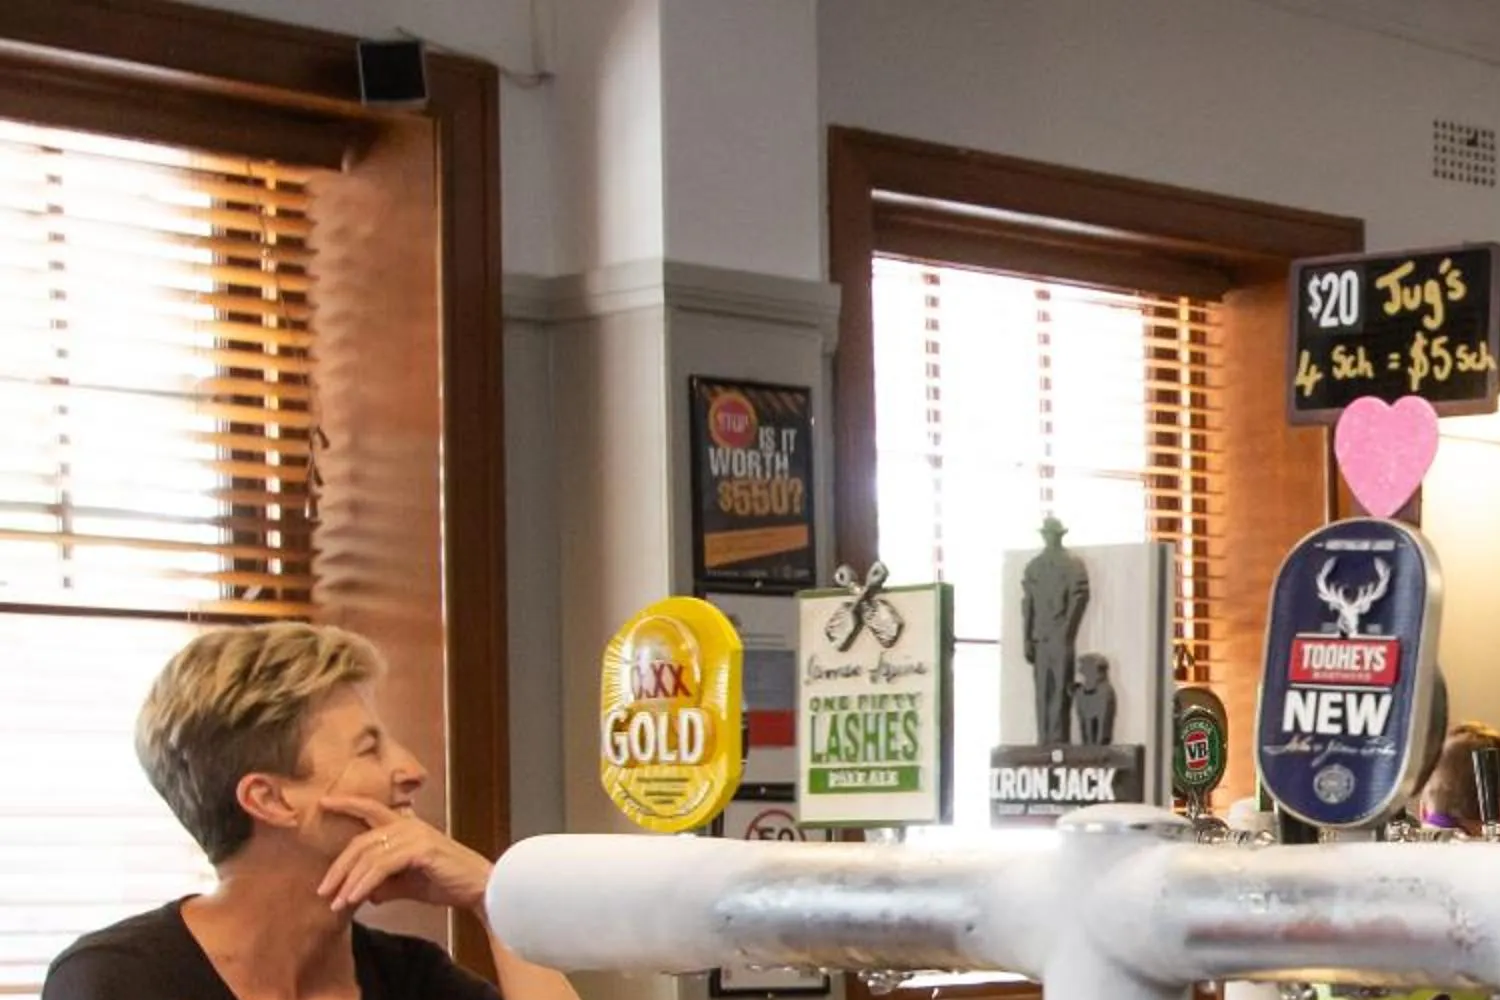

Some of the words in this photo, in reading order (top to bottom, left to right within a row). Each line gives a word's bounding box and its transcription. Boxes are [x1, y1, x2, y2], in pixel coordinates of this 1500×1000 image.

[1308, 269, 1359, 328] $20
[1375, 258, 1467, 330] Jug's
[1295, 350, 1324, 396] 4
[759, 426, 775, 451] IS
[781, 429, 797, 452] IT
[709, 447, 790, 481] WORTH
[718, 476, 805, 517] $550?
[1302, 641, 1388, 672] TOOHEYS
[604, 703, 705, 767] GOLD
[1282, 690, 1393, 737] NEW
[809, 710, 920, 764] LASHES
[988, 767, 1048, 800] IRON
[1050, 767, 1116, 800] JACK
